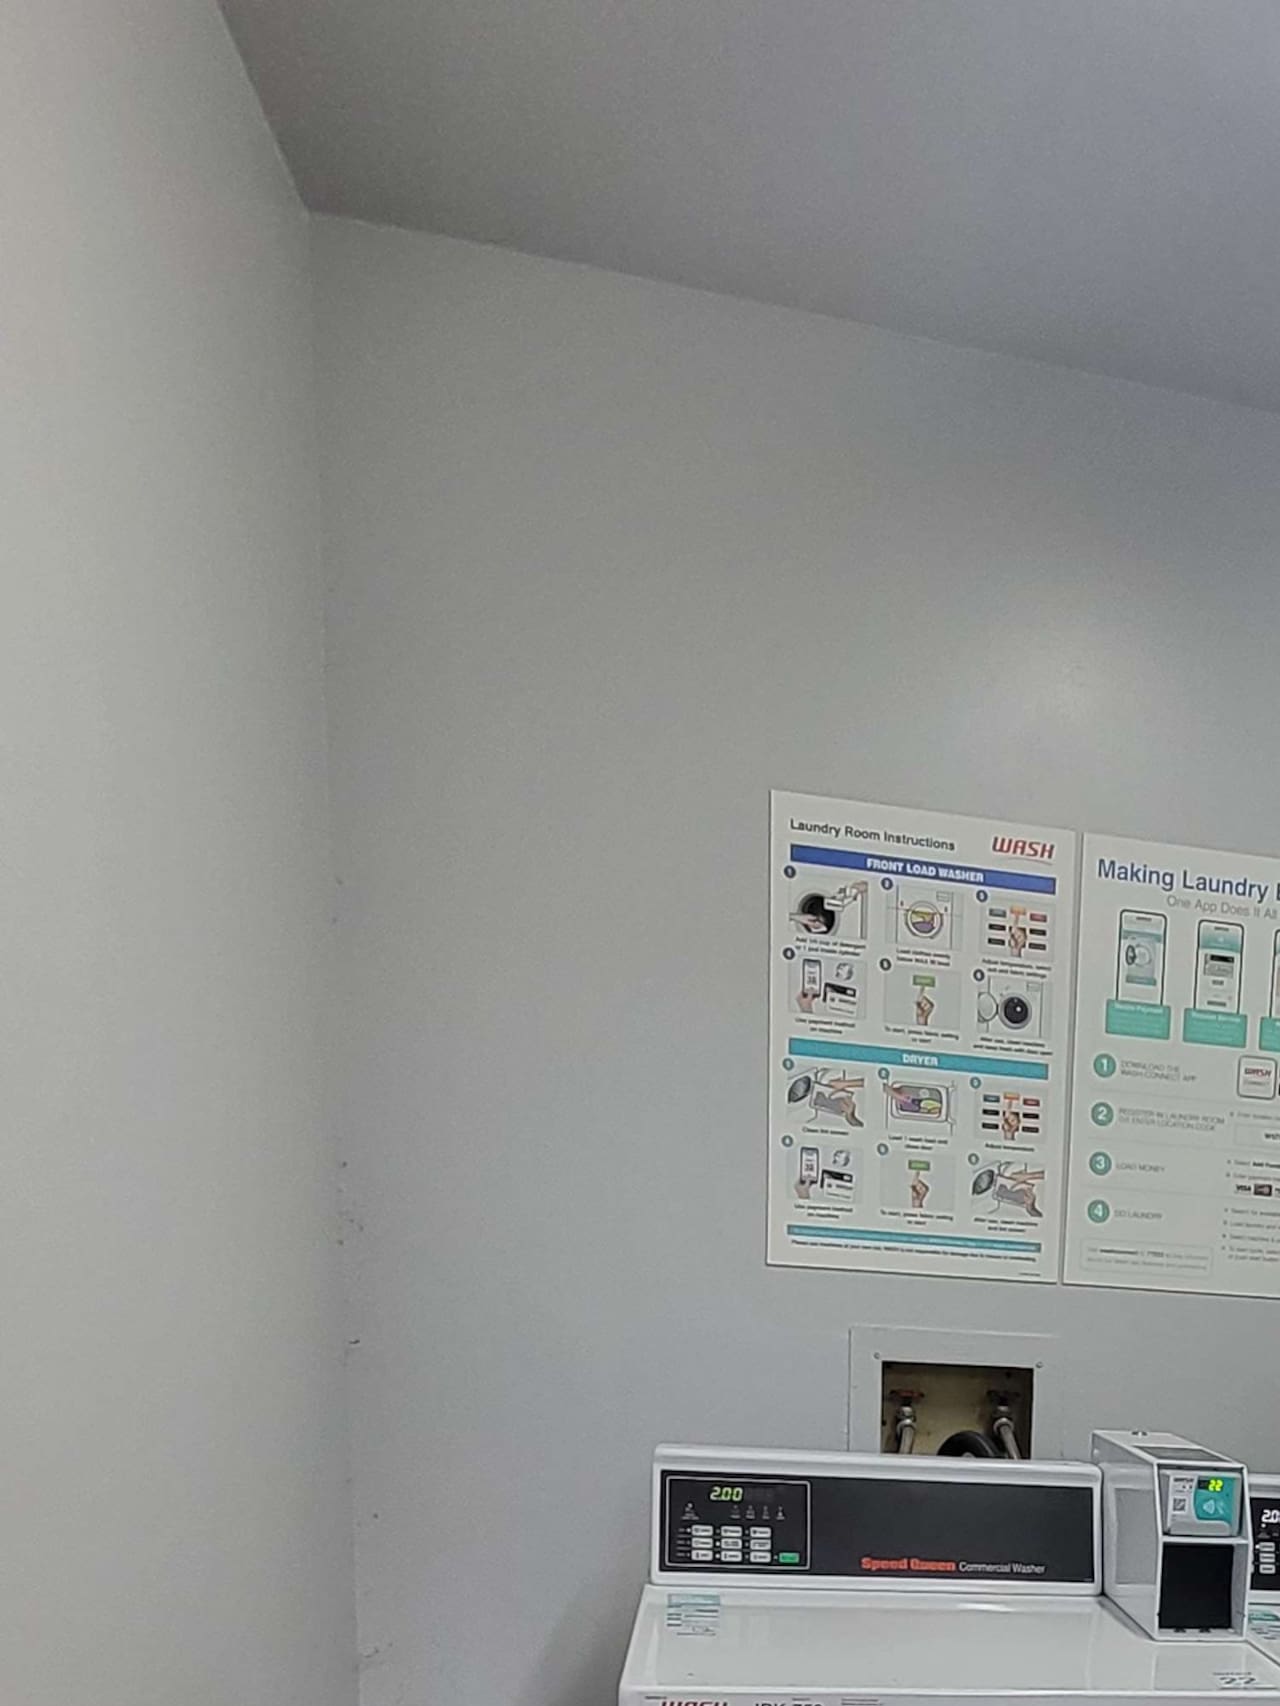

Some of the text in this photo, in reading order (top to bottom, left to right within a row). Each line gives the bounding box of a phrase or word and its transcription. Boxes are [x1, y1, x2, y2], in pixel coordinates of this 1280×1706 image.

[790, 818, 955, 851] Laundry Room Instructions
[992, 836, 1055, 860] WASH
[866, 858, 984, 884] FRONT LOAD WASHER
[1097, 858, 1175, 891] Making
[1182, 870, 1269, 904] Laundry
[1166, 895, 1278, 920] One App Does It All
[902, 1053, 939, 1067] DRYER
[1101, 1057, 1109, 1073] 1
[1097, 1106, 1107, 1121] 2
[1095, 1155, 1105, 1170] 3
[1208, 1478, 1224, 1492] 22
[861, 1557, 1046, 1575] Speed Queen Commercial Washer
